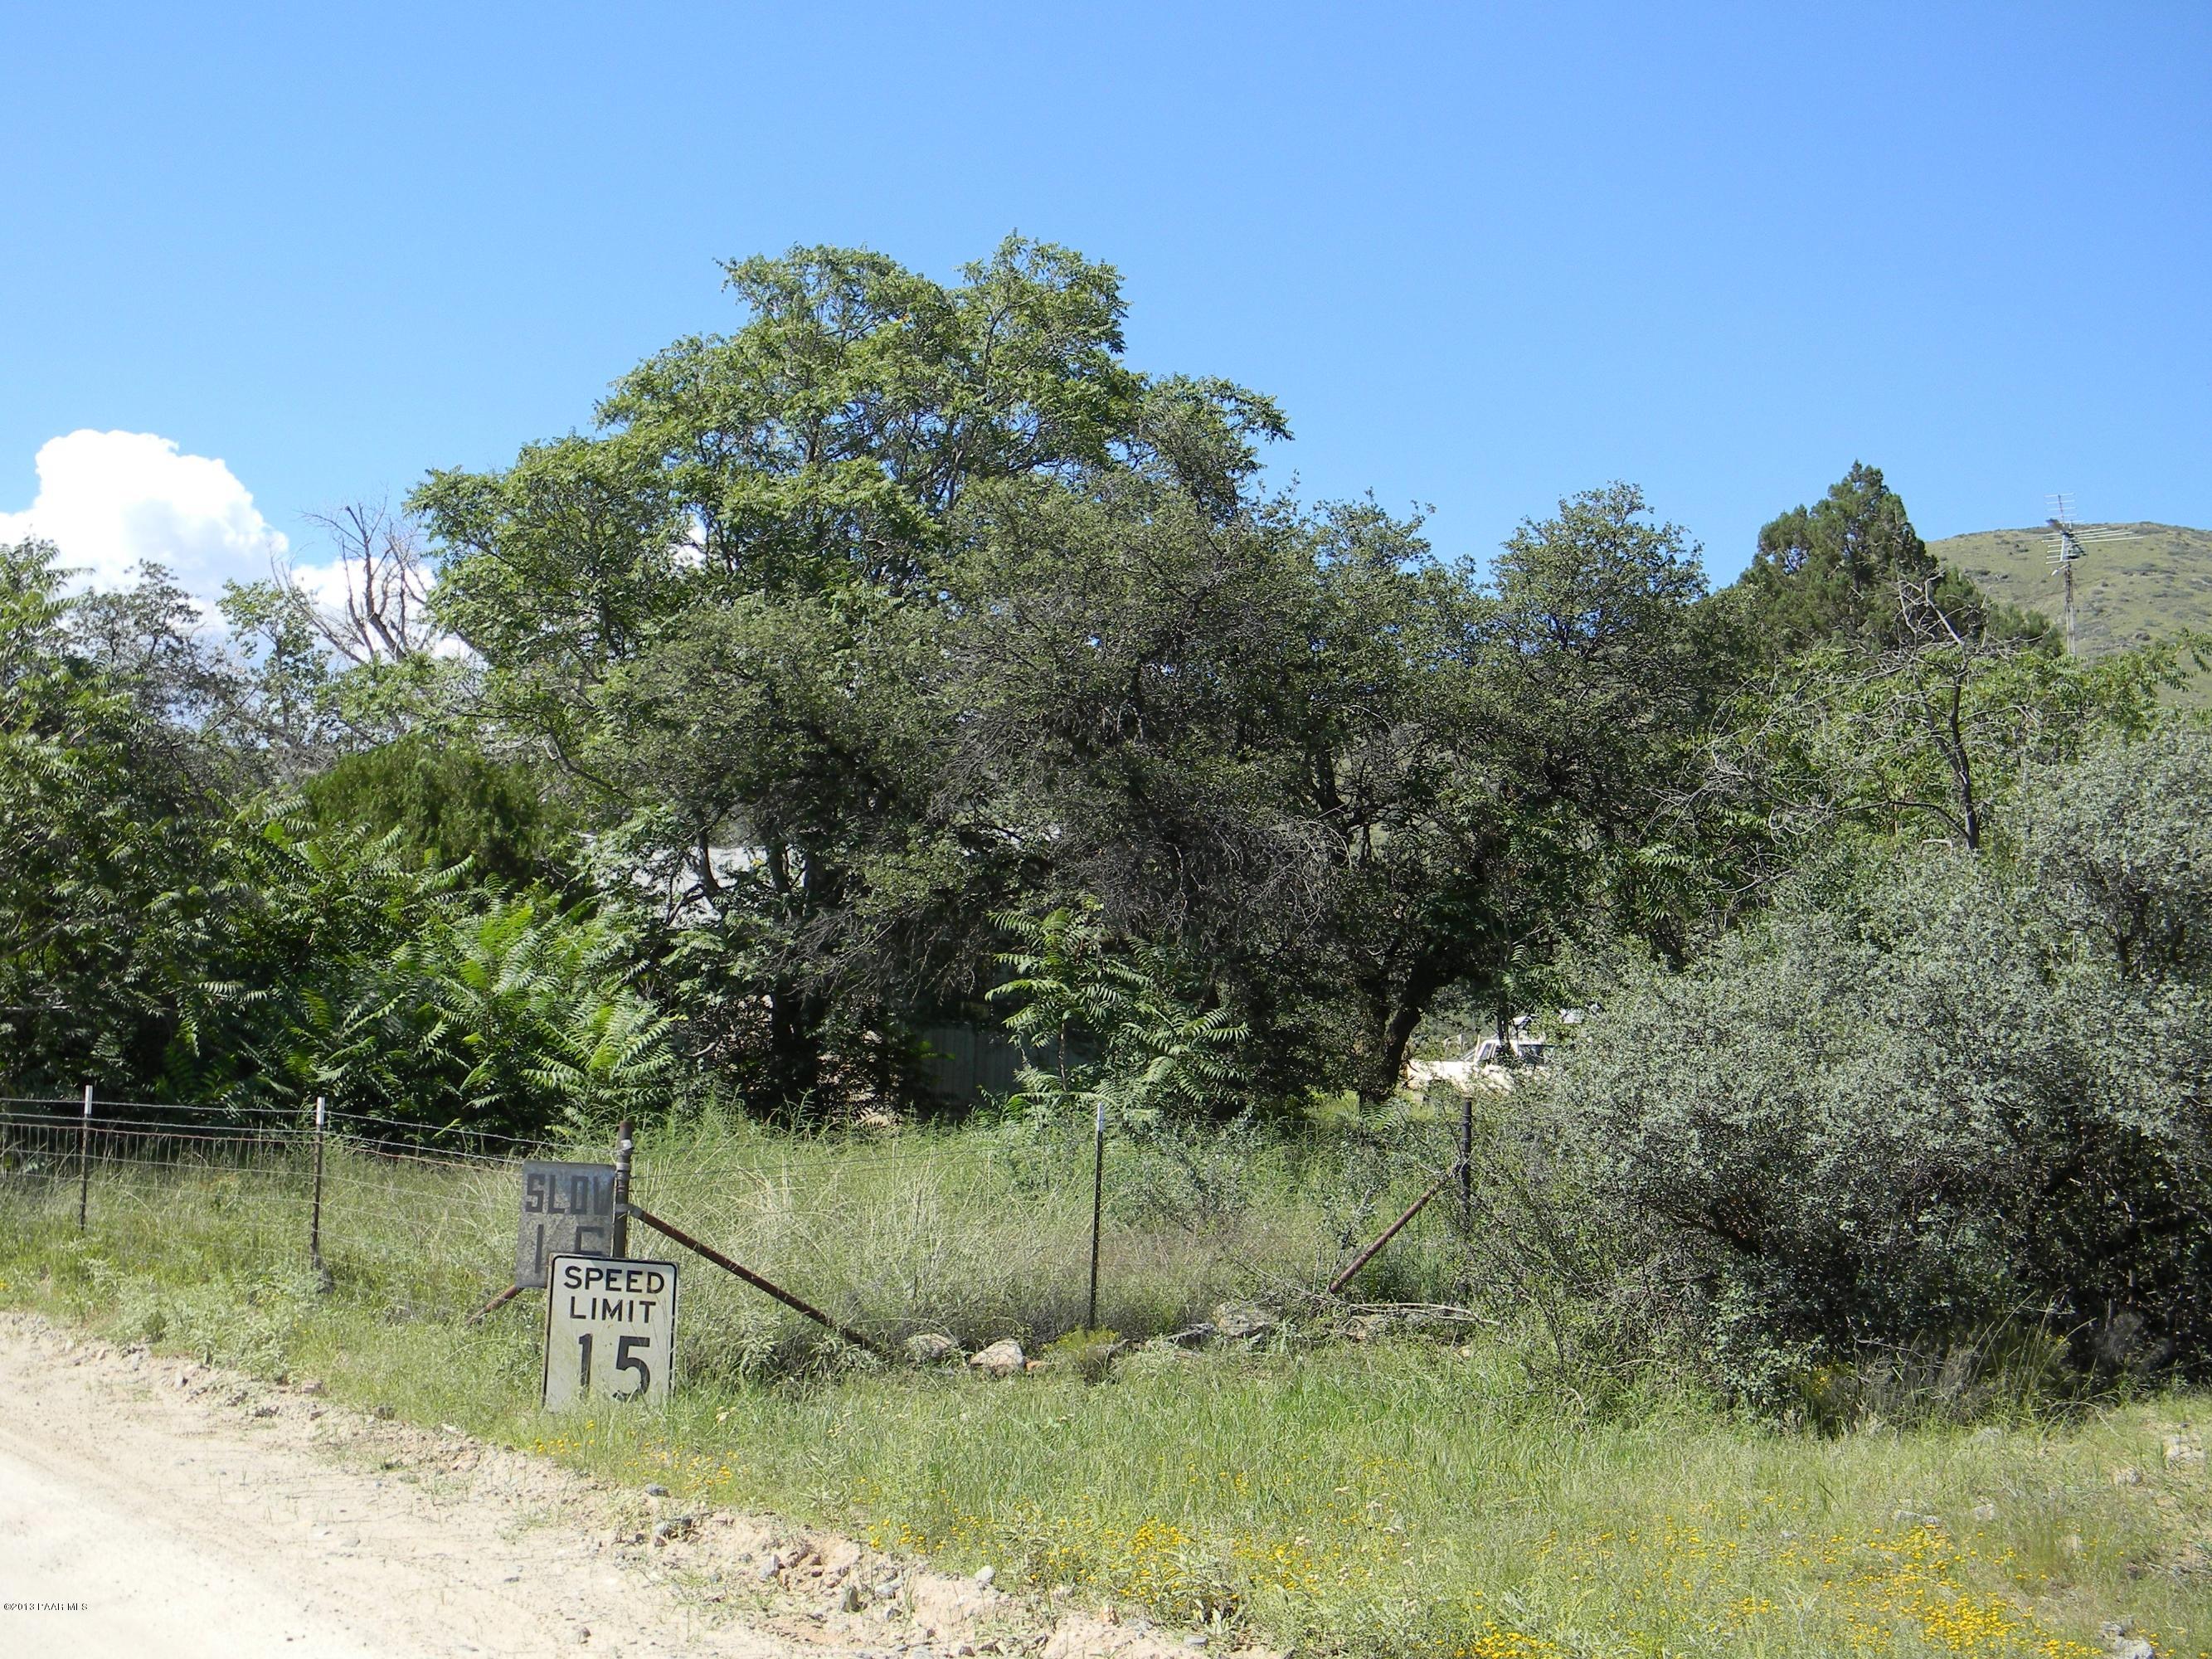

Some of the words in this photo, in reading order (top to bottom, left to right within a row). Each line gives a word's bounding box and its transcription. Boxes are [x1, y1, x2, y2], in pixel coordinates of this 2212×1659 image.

[525, 1173, 615, 1215] SLOW
[563, 1265, 664, 1295] SPEED
[569, 1296, 656, 1324] LIMIT
[578, 1332, 651, 1403] 15
